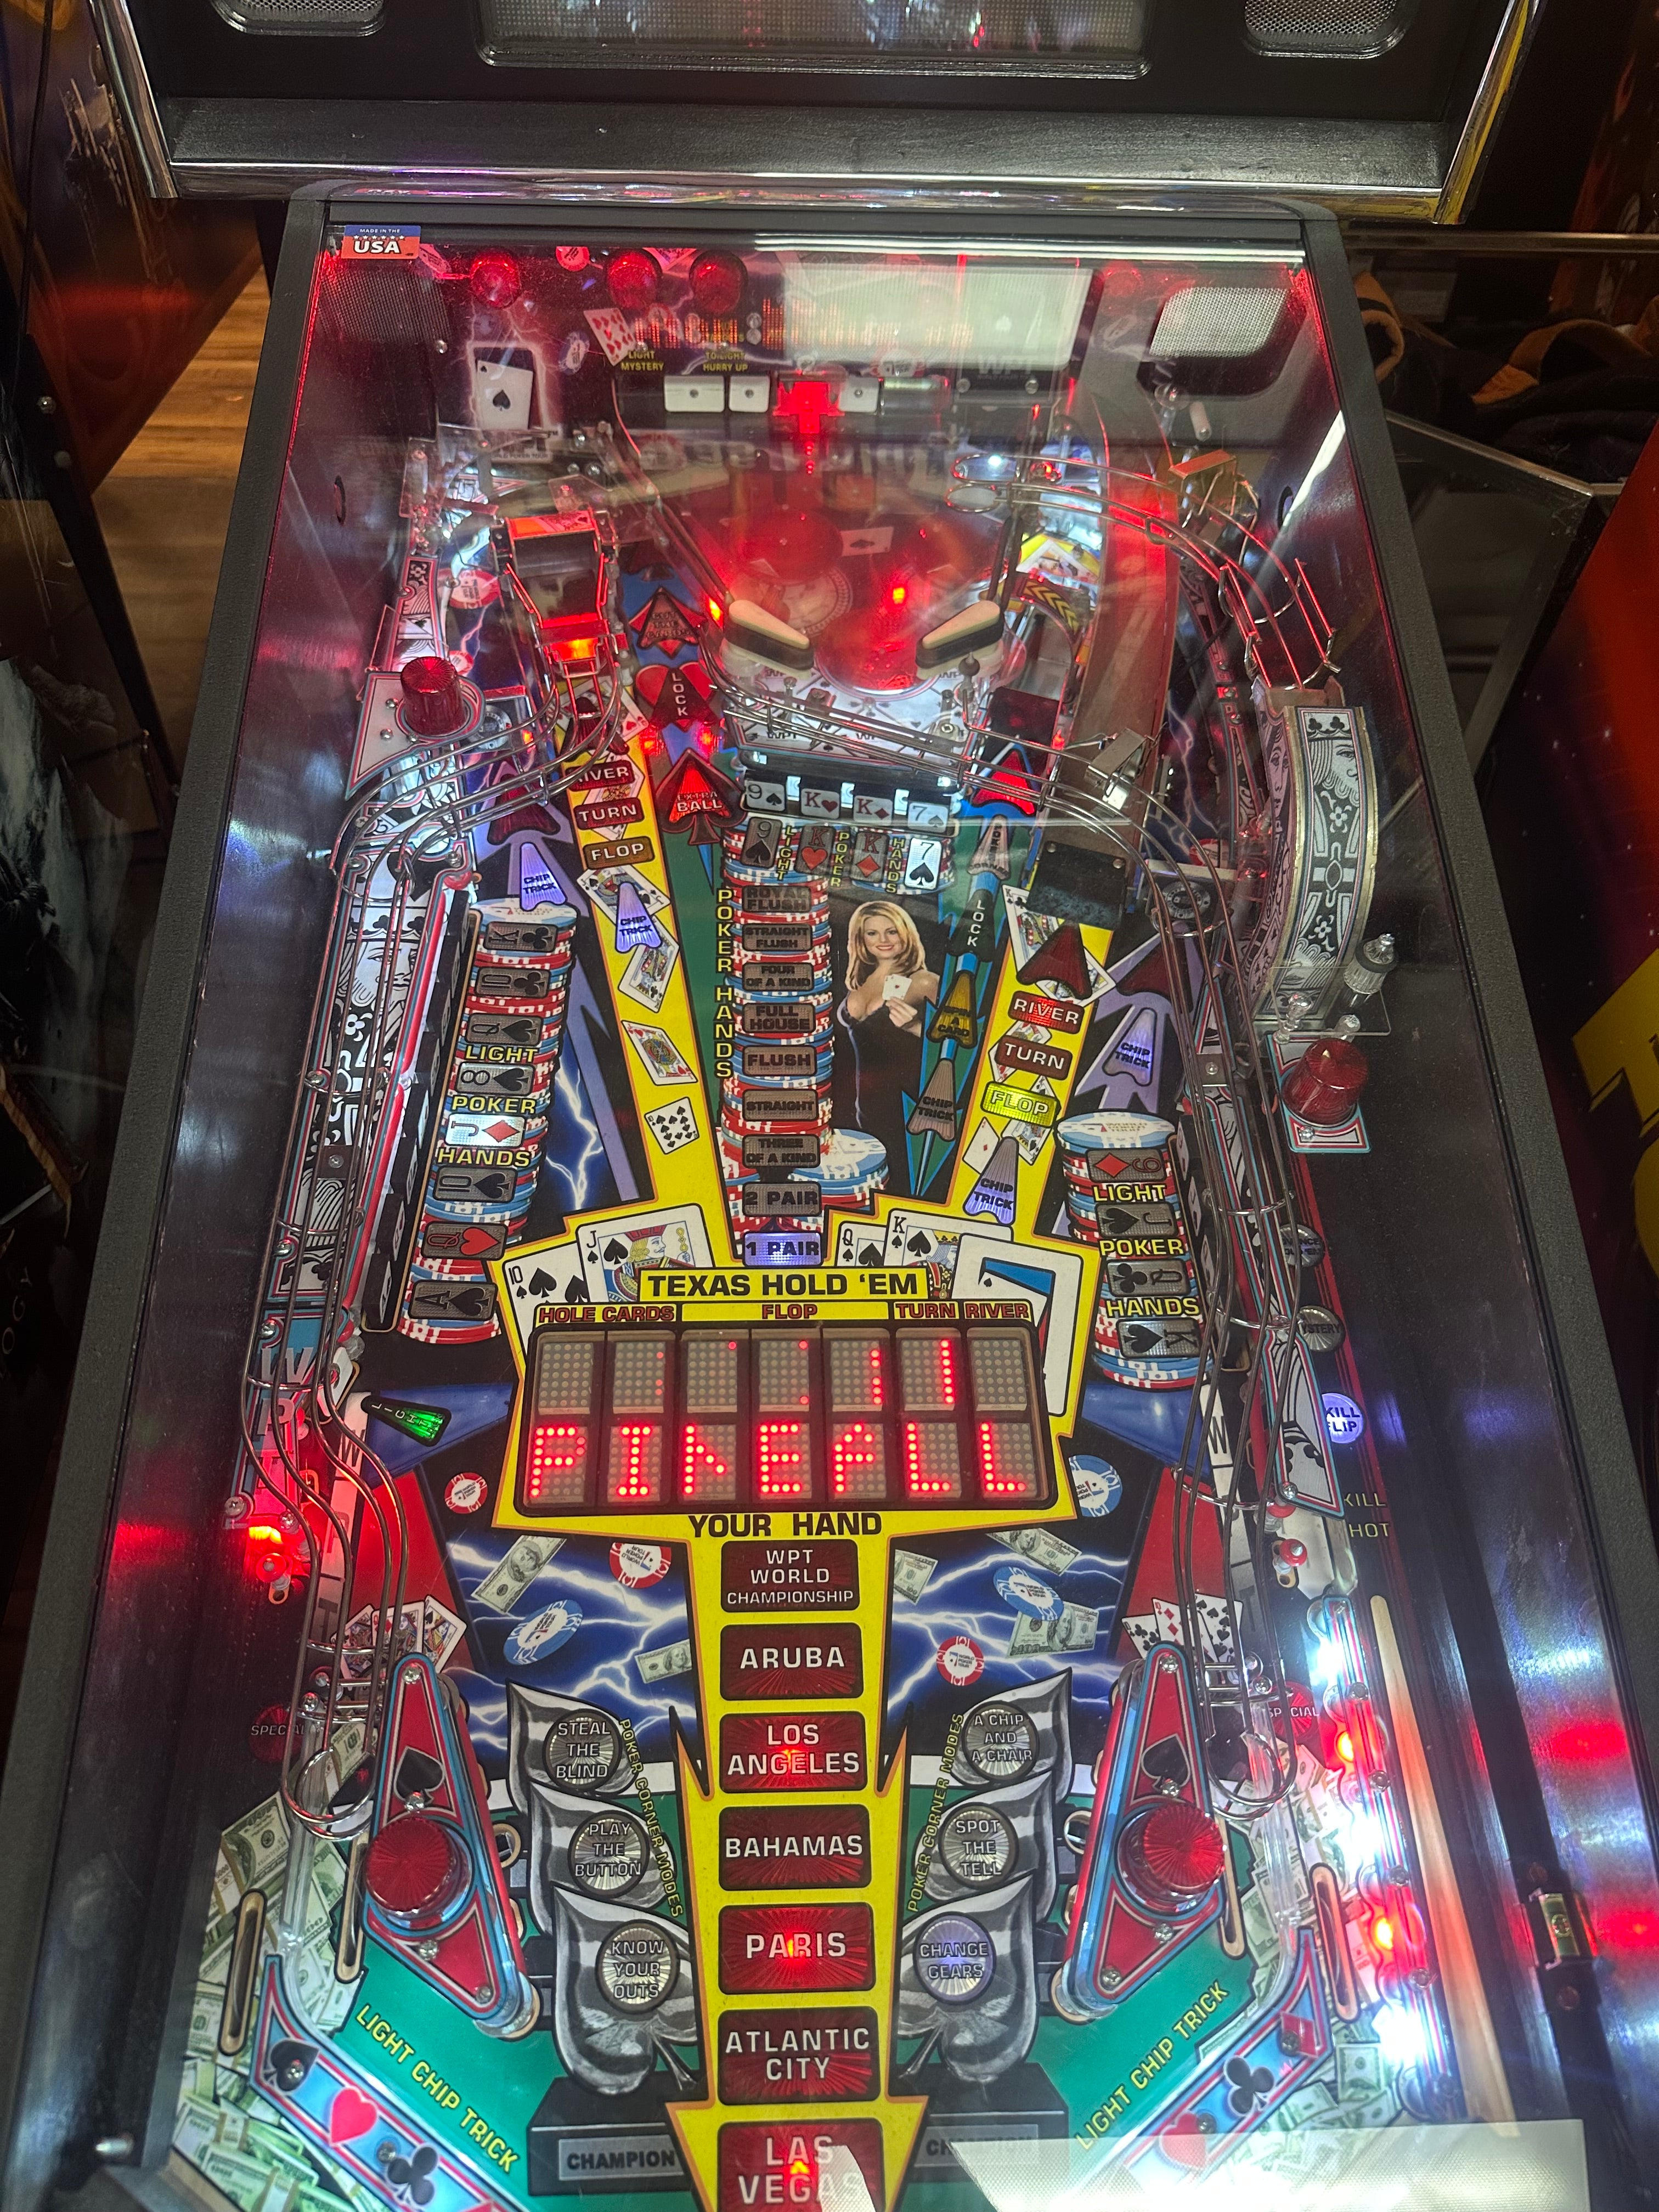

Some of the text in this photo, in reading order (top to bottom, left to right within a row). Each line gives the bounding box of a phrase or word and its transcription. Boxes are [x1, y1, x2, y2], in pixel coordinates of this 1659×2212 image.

[353, 241, 400, 253] USA
[621, 362, 664, 371] MYSTERY
[703, 363, 748, 371] HURRY UP
[672, 673, 689, 716] LOCK
[577, 765, 630, 783] IVER
[677, 791, 718, 800] EXTRA
[747, 783, 763, 799] 9
[677, 799, 723, 812] BALL
[805, 791, 821, 808] K
[857, 798, 873, 815] K
[578, 804, 637, 822] TURN
[912, 805, 927, 822] 7
[757, 821, 772, 837] 9
[811, 828, 828, 847] K
[864, 834, 882, 854] K
[591, 842, 645, 861] FLOP
[777, 825, 795, 881] LIGHT
[921, 842, 935, 860] 7
[830, 832, 850, 888] POKER
[885, 838, 906, 894] HANDS
[524, 873, 550, 884] CHIP
[523, 883, 557, 894] TRICK
[747, 887, 807, 898] ROYAL
[747, 899, 807, 911] FLUSH
[620, 915, 647, 926] CHIP
[967, 900, 985, 947] LOCK
[619, 924, 653, 936] TRICK
[744, 927, 809, 936] STRAIGHT
[756, 939, 798, 948] FLUSH
[761, 966, 795, 974] FOUR
[715, 889, 733, 1078] POKER HANDS
[746, 978, 811, 987] OF A KIND
[756, 1006, 799, 1017] FULL
[1013, 999, 1079, 1025] RIVER
[749, 1018, 810, 1030] HOUSE
[937, 1024, 970, 1037] CARD
[465, 1045, 539, 1063] LIGHT
[1005, 1043, 1065, 1069] TURN
[1120, 1042, 1151, 1055] CHIP
[748, 1054, 811, 1066] FLUSH
[1114, 1051, 1151, 1069] TRICK
[461, 1070, 490, 1086] 8
[451, 1097, 537, 1114] POKER
[746, 1102, 814, 1111] STRAIGHT
[922, 1097, 953, 1108] CHIP
[989, 1091, 1048, 1115] FLOP
[918, 1107, 955, 1121] TRICK
[758, 1138, 804, 1148] THREE
[437, 1148, 531, 1167] HANDS
[746, 1154, 817, 1164] OF A KIND
[980, 1178, 1014, 1193] CHIP
[1093, 1184, 1166, 1203] LIGHT
[746, 1192, 818, 1206] 2 PAIR
[973, 1191, 1014, 1209] TRICK
[892, 1216, 907, 1234] K
[586, 1230, 597, 1249] J
[842, 1228, 854, 1247] Q
[746, 1241, 820, 1256] 1 PAIR
[1098, 1238, 1184, 1256] POKER
[509, 1266, 523, 1285] 10
[647, 1274, 751, 1296] TEXAS
[762, 1273, 848, 1296] HOLD
[538, 1306, 675, 1323] HOLE CARDS
[761, 1304, 819, 1320] FLOP
[895, 1302, 956, 1319] TURN
[964, 1302, 1030, 1319] RIVER
[1105, 1297, 1200, 1317] HANDS
[371, 1402, 430, 1427] LIGHT
[1325, 1407, 1361, 1418] KILL
[1344, 1493, 1387, 1508] KILL
[688, 1513, 882, 1538] YOUR HAND
[1349, 1523, 1390, 1538] HOT
[766, 1549, 813, 1565] WPT
[751, 1568, 830, 1584] WORLD
[727, 1590, 854, 1605] CHAMPIONSHIP
[740, 1646, 845, 1669] ARUBA
[974, 1714, 1024, 1726] A CHIP
[1269, 1707, 1320, 1718] SPCIAL
[557, 1721, 611, 1736] STEAL
[768, 1724, 820, 1746] LOS
[984, 1731, 1017, 1744] AND
[567, 1742, 600, 1757] THE
[972, 1749, 1033, 1762] A CHAIR
[556, 1764, 608, 1779] BLIND
[727, 1752, 860, 1776] ANGELES
[619, 1718, 684, 1918] POKER CORNER MODES
[907, 1713, 966, 1912] POKER CORNER MODES
[589, 1822, 631, 1836] PLAY
[955, 1819, 1001, 1833] SPOT
[593, 1843, 625, 1856] THE
[726, 1835, 862, 1858] BAHAMAS
[962, 1841, 997, 1855] THE
[574, 1863, 642, 1877] BUTTON
[960, 1861, 1002, 1876] TELL
[612, 1940, 665, 1955] KNOW
[746, 1932, 847, 1959] PARIS
[919, 1942, 989, 1956] CHANGE
[614, 1962, 661, 1977] YOUR
[927, 1964, 984, 1979] GEARS
[613, 1984, 659, 1999] OUTS
[725, 2027, 870, 2053] ATLANTIC
[766, 2057, 830, 2081] CITY
[1074, 1980, 1229, 2151] LIGHT CHIP TRICK
[356, 2004, 520, 2173] LIGHT CHIP TRICK
[766, 2136, 833, 2166] LAS
[567, 2149, 676, 2171] CHAMPION
[738, 2170, 867, 2205] VEGAS
